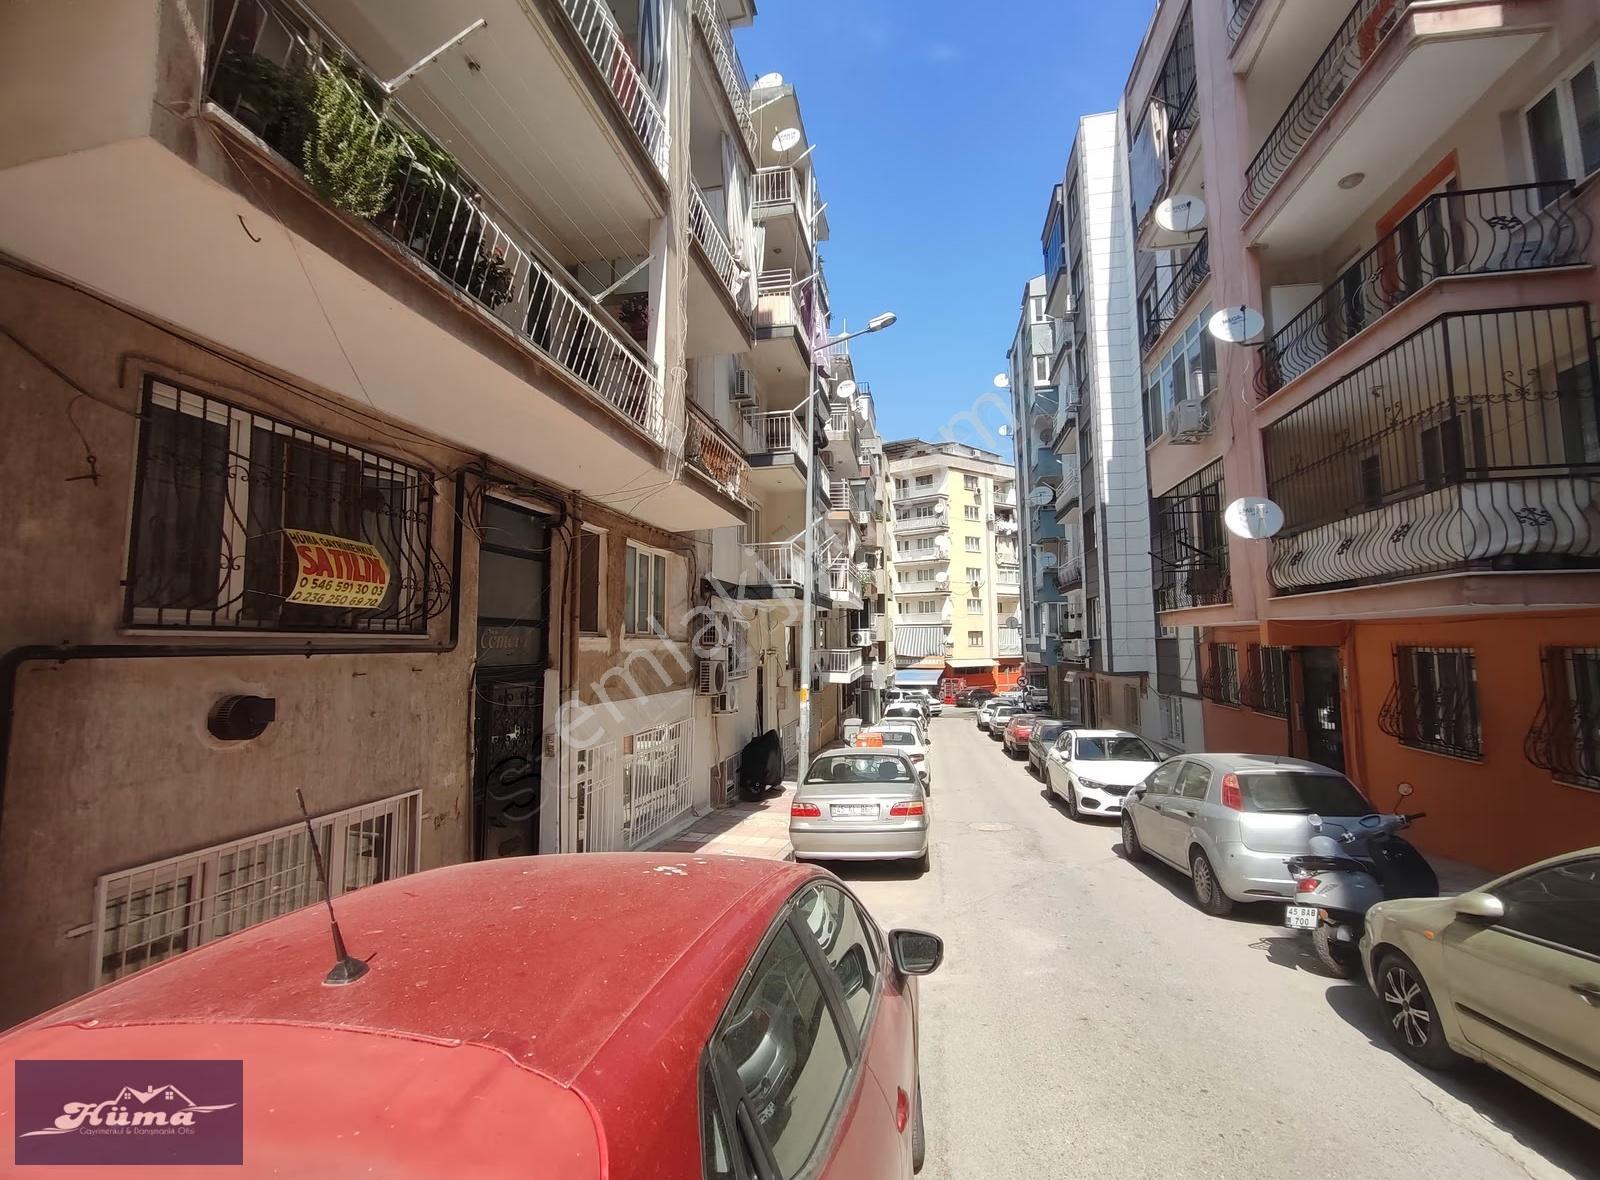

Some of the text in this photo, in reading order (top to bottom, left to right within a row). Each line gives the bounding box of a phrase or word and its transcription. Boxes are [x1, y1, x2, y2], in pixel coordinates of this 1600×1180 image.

[300, 577, 385, 596] 0 546 591 30 03
[292, 590, 302, 601] 0
[303, 592, 324, 603] 236
[327, 594, 348, 605] 250
[350, 596, 363, 606] 69
[1295, 918, 1309, 926] 700
